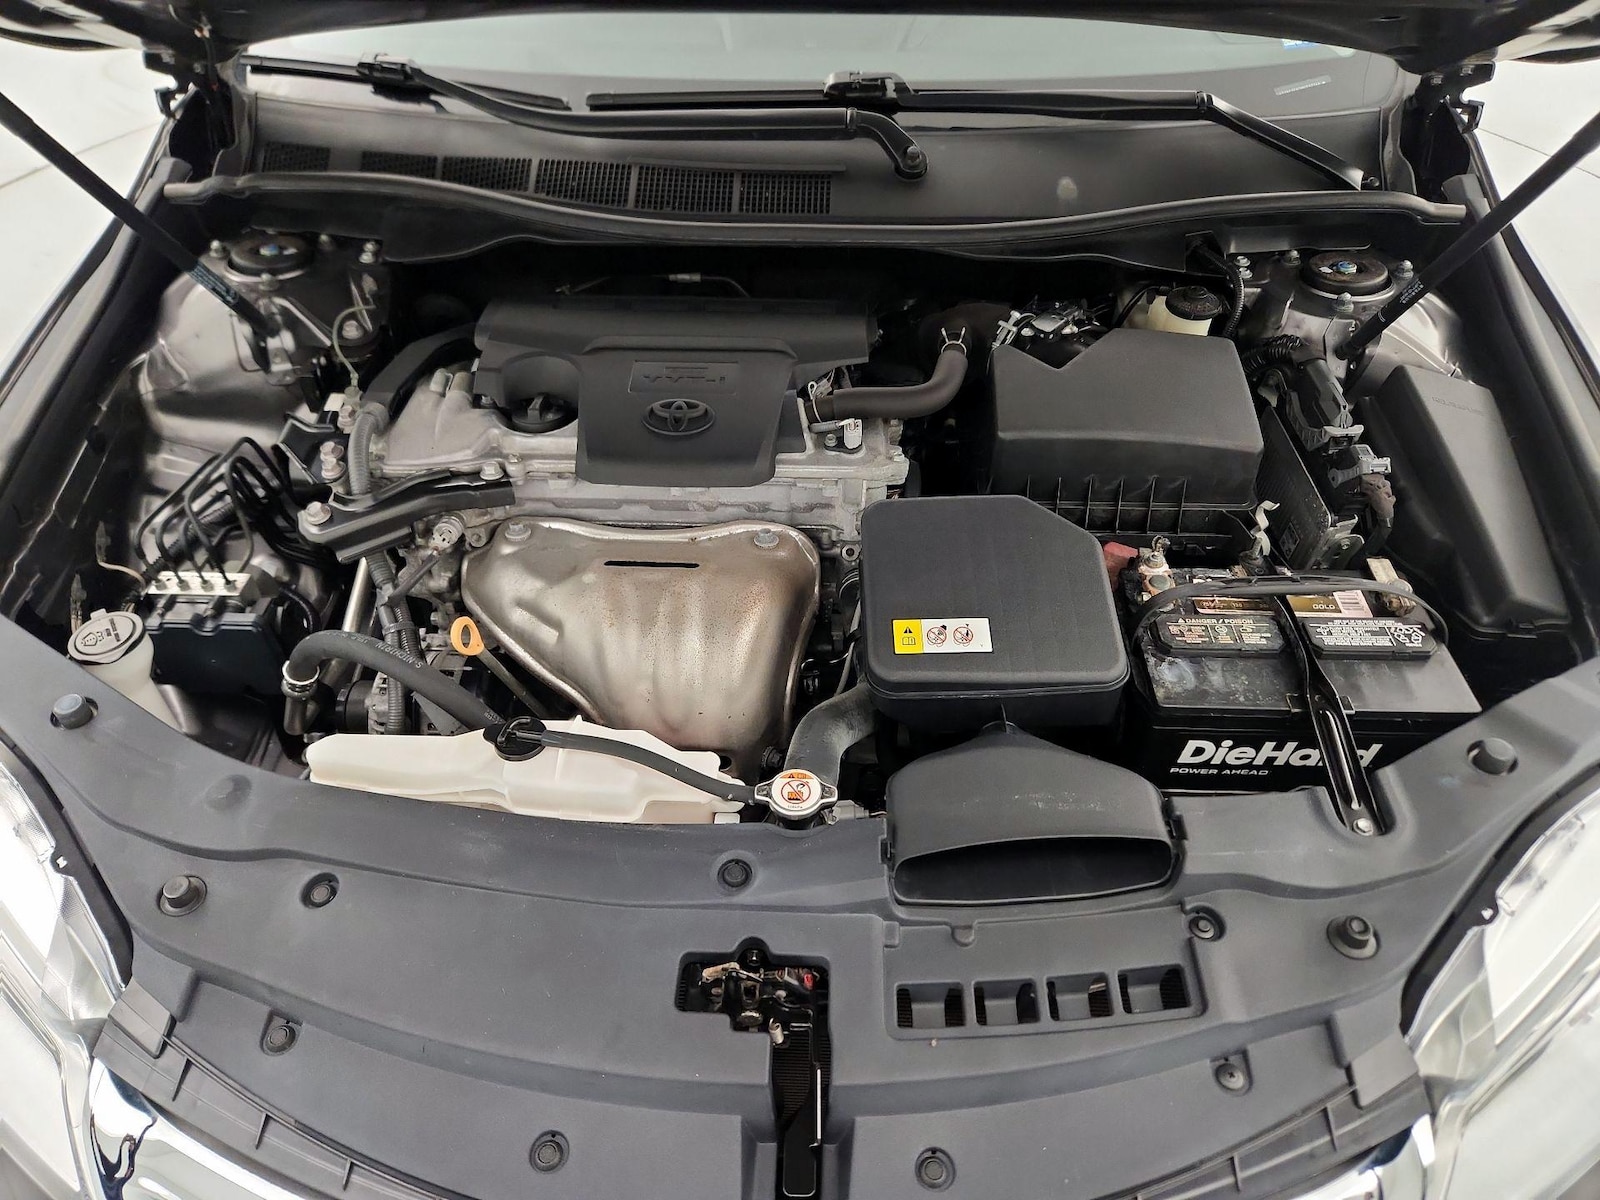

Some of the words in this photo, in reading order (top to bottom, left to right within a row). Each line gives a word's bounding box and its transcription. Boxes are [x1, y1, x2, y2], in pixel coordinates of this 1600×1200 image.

[1177, 739, 1384, 768] DieHad
[1169, 767, 1219, 775] POWER
[1221, 768, 1270, 776] AHEAD
